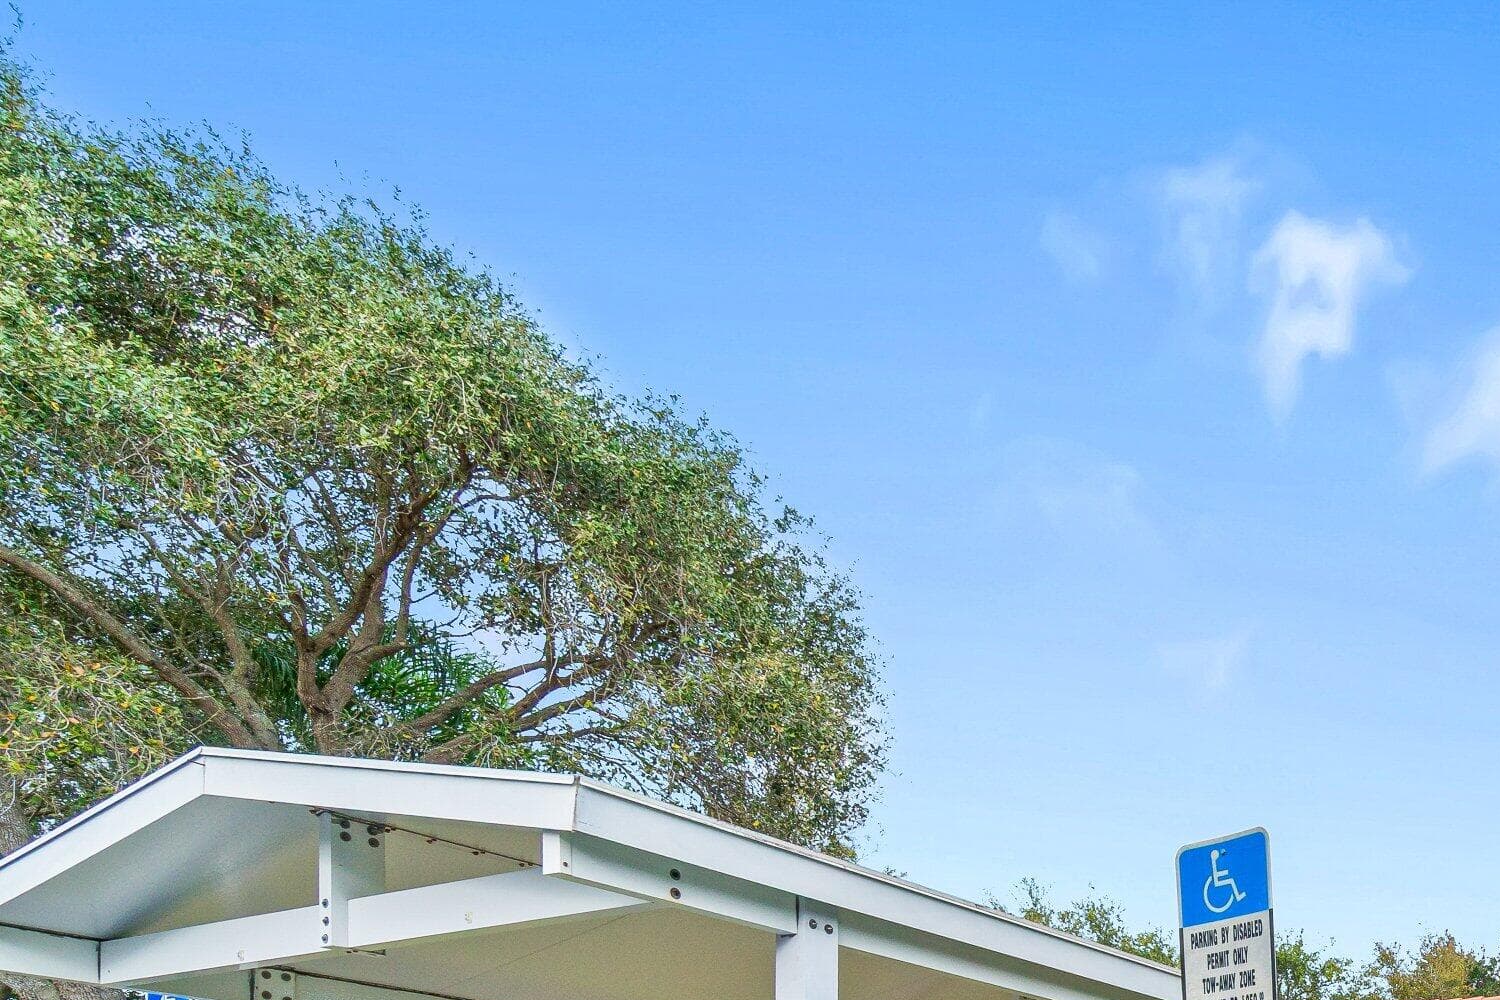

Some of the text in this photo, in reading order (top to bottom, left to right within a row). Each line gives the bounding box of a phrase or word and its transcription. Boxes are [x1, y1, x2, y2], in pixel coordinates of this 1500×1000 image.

[1191, 919, 1263, 949] PARKING BY DISABLED
[1207, 947, 1248, 970] PERMIT ONLY
[1203, 969, 1256, 995] TOW-AWAY ZONE
